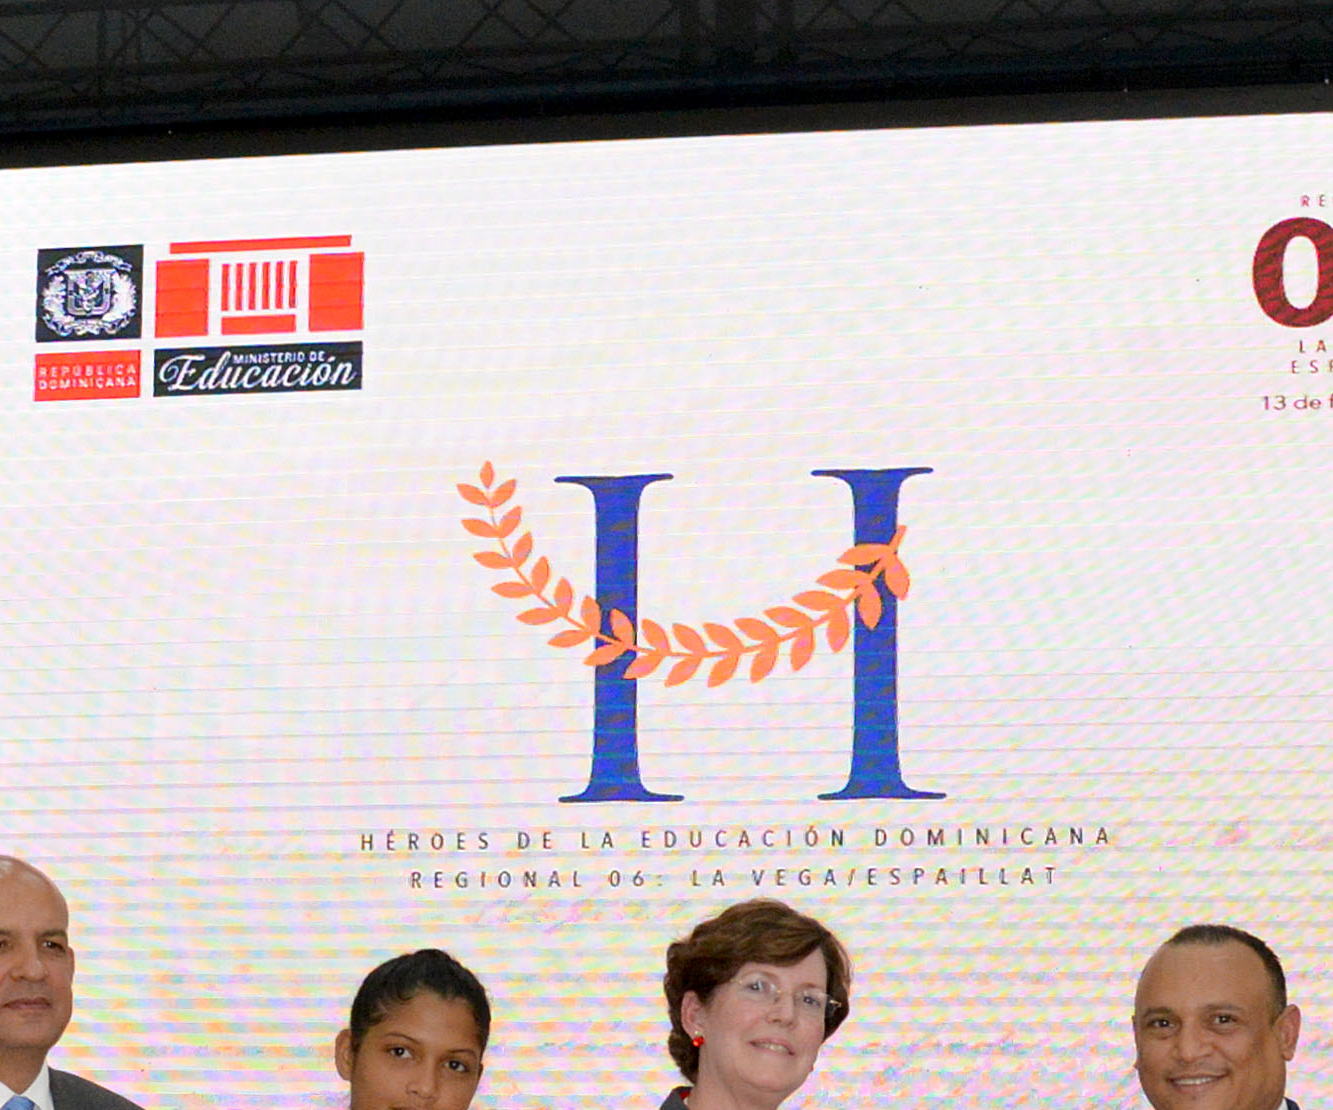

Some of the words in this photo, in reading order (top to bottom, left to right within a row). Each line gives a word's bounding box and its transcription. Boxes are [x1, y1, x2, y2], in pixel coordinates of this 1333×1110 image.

[1298, 338, 1327, 353] LA
[232, 351, 305, 364] MINISTERIO
[309, 351, 326, 362] DE
[159, 350, 358, 391] Educación
[39, 377, 136, 390] DOMINICANA
[1263, 395, 1287, 411] 13
[1294, 394, 1322, 410] de
[361, 829, 489, 851] HÉROES
[517, 831, 553, 850] DE
[581, 831, 615, 849] LA
[642, 825, 845, 848] EDUCACIÓN
[875, 827, 1110, 847] DOMINICANA
[410, 869, 583, 889] REGIONAL
[609, 869, 662, 887] 06:
[691, 869, 726, 887] LA
[751, 867, 1058, 887] VEGA/ESPAILLAT
